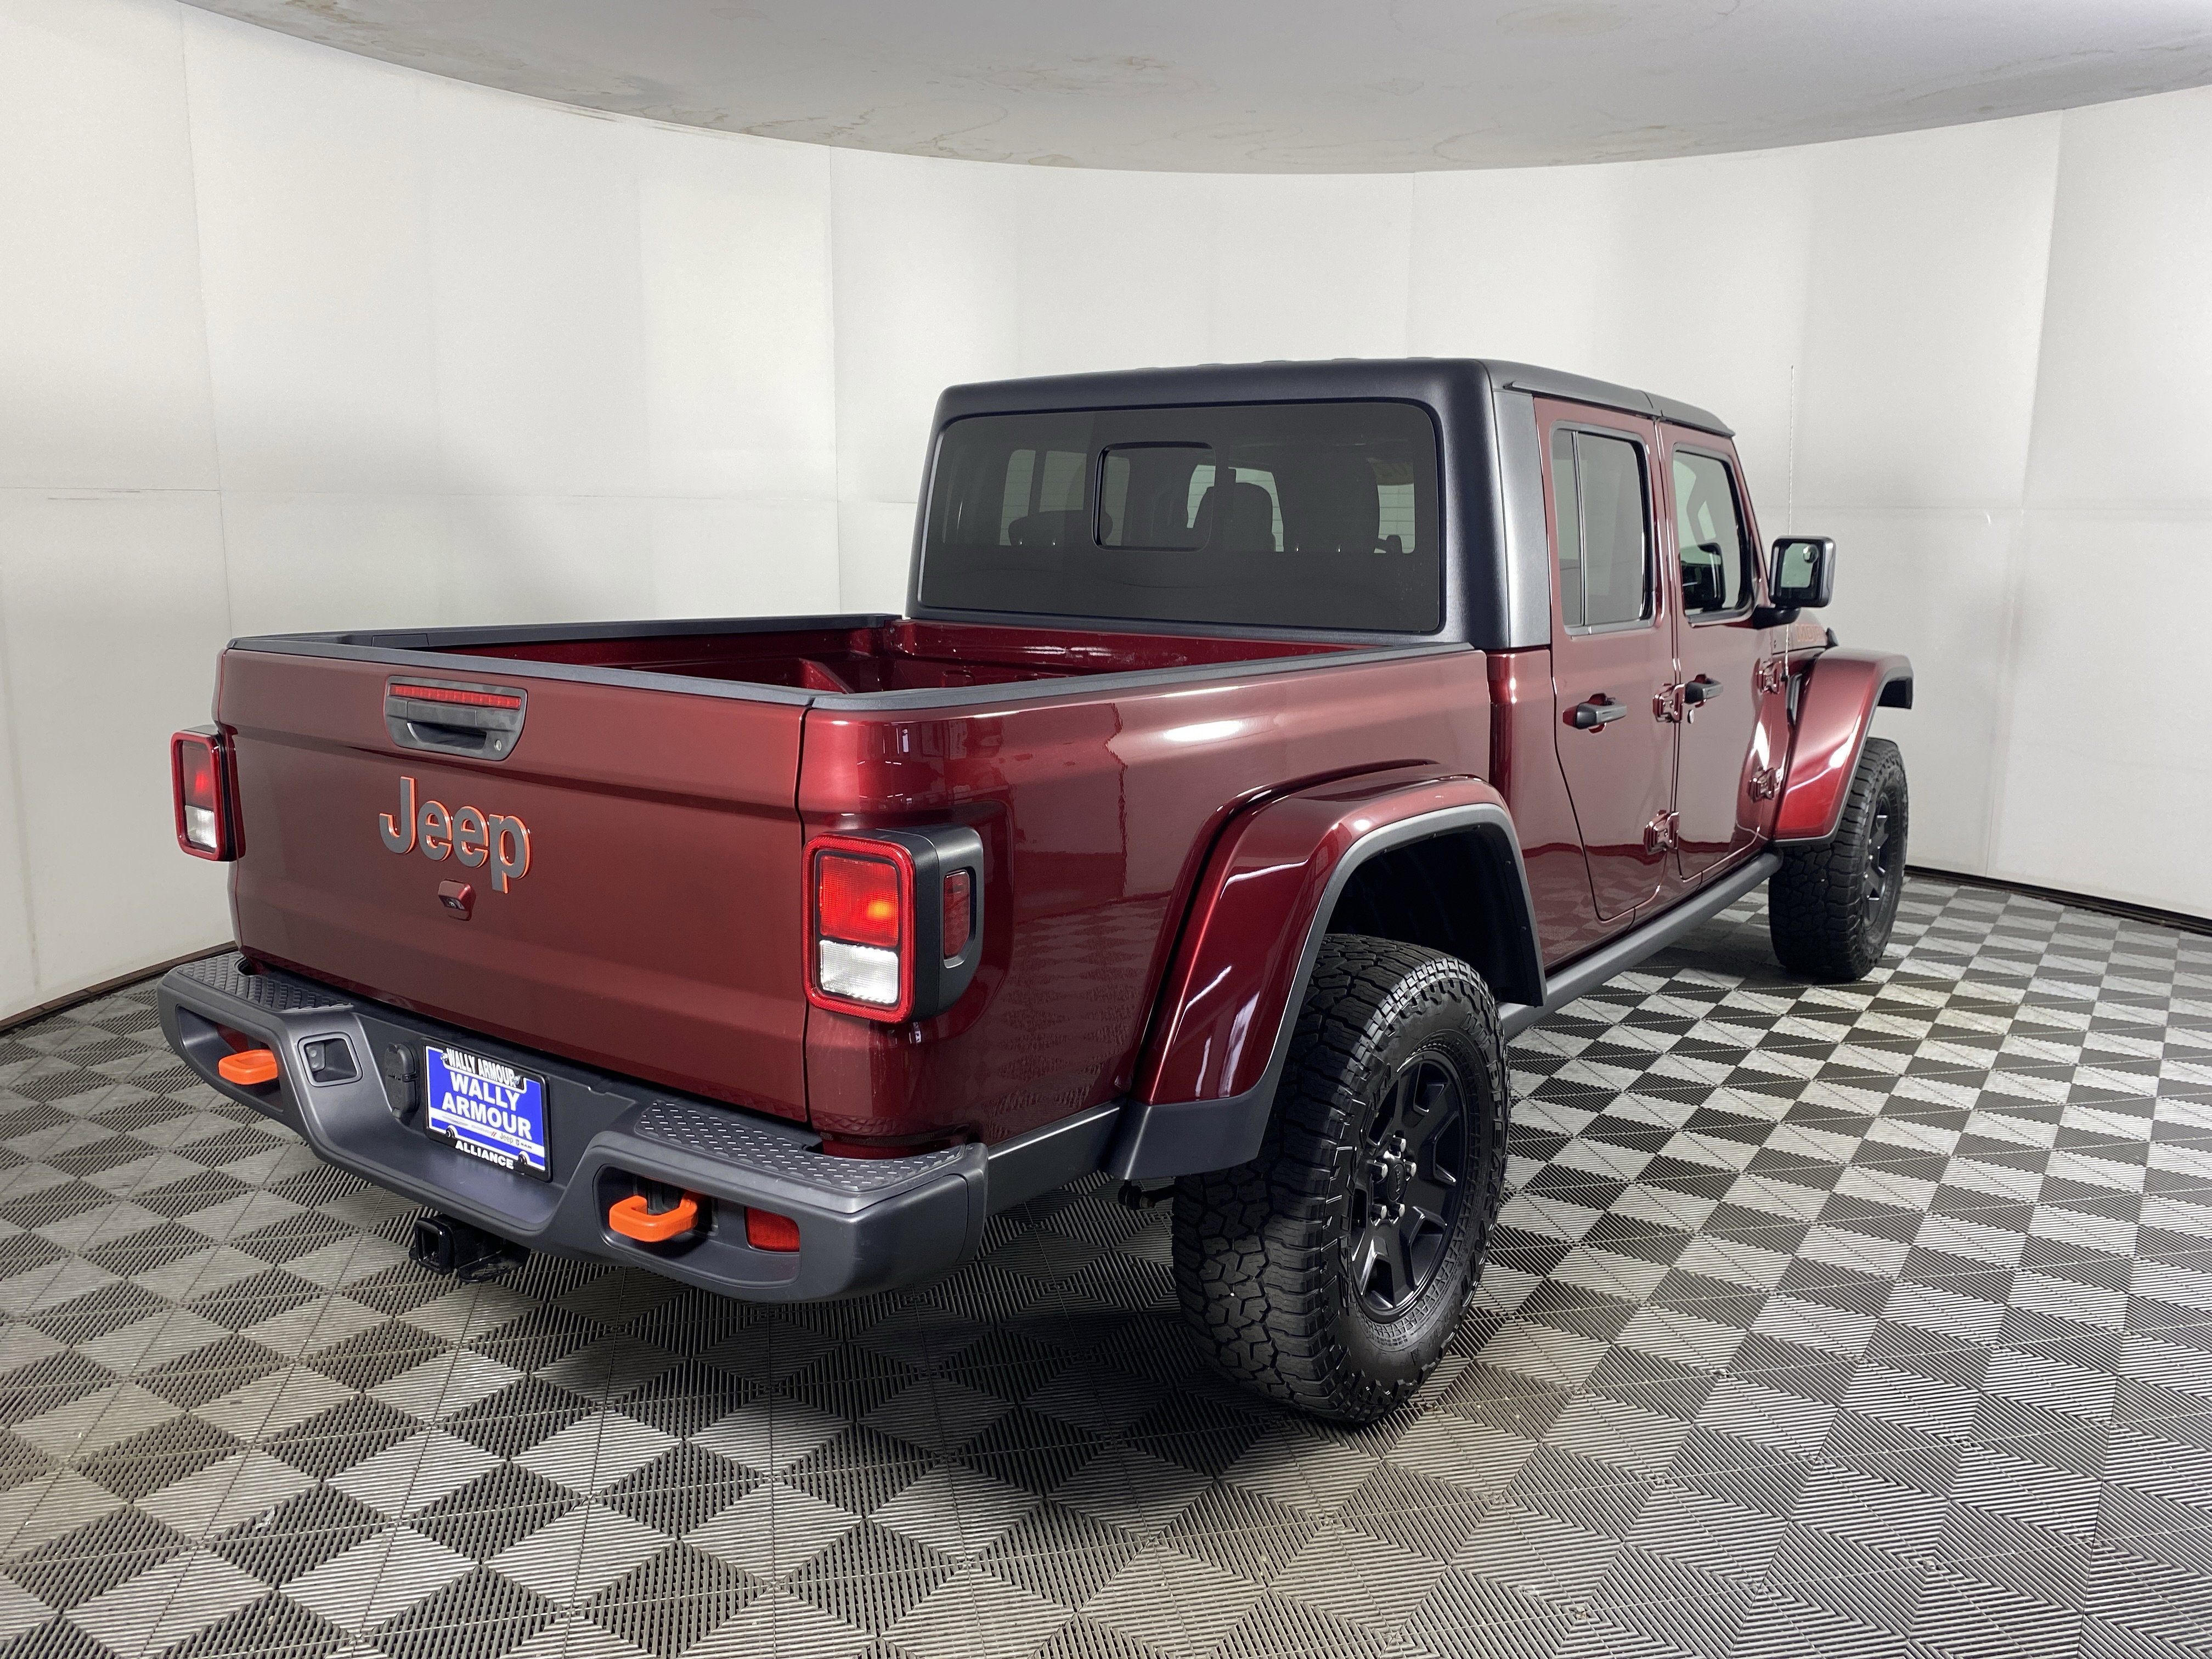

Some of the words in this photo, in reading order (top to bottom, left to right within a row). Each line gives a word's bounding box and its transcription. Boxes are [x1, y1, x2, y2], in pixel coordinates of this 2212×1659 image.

[379, 776, 532, 894] Jeep
[446, 1048, 476, 1074] WALLY
[478, 1058, 517, 1088] ARMOUR
[450, 1071, 520, 1111] WALLY
[442, 1092, 533, 1141] ARMOUR
[455, 1140, 514, 1170] ALLIANCE
[499, 1132, 514, 1144] Jeep
